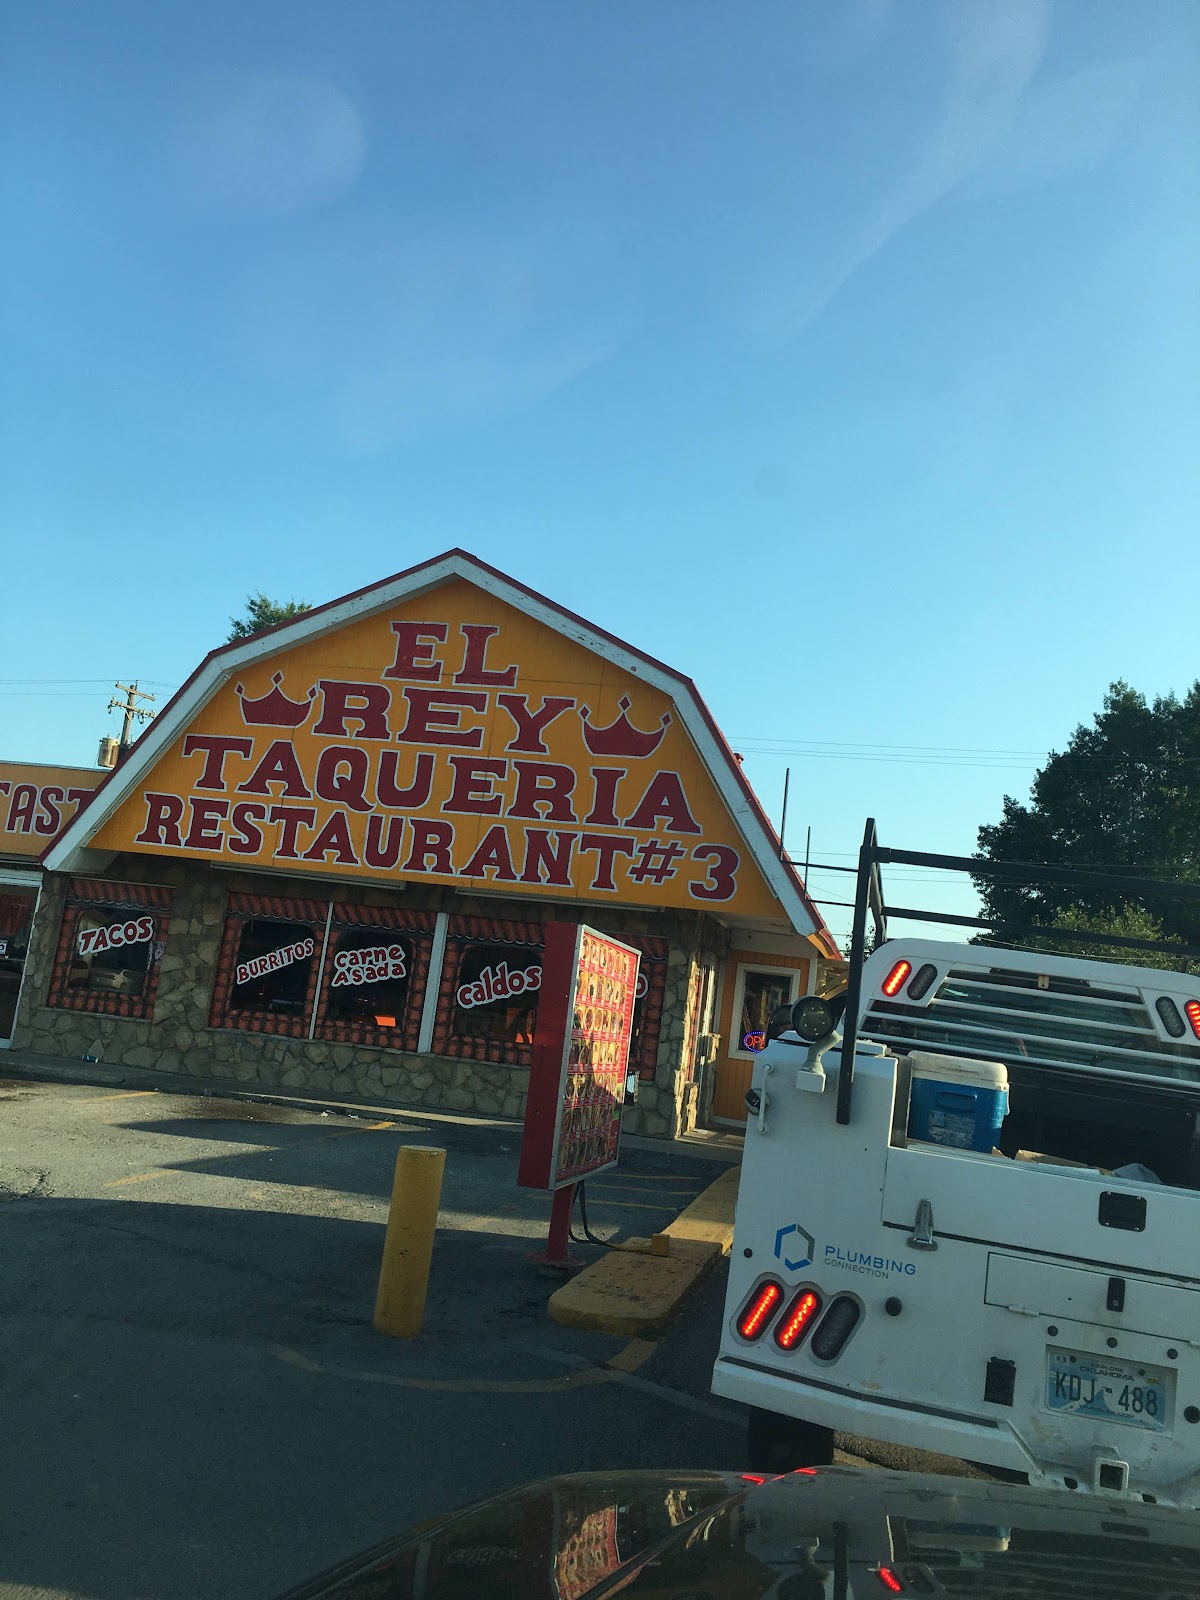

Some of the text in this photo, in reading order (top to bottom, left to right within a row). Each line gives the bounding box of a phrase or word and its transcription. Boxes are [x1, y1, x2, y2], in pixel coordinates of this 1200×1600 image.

[381, 621, 519, 688] EL
[311, 679, 577, 755] REY
[182, 734, 703, 836] TAQUERIA
[133, 791, 636, 892] RESTAURANT
[78, 916, 153, 955] TACOS
[236, 938, 314, 985] BURRITOS
[331, 962, 406, 987] Asada
[457, 961, 542, 1009] caldos
[745, 1035, 765, 1049] OPE
[824, 1258, 889, 1279] CONNECTION
[825, 1245, 916, 1275] PLUMBING
[1080, 1366, 1134, 1382] OKLAHOMA
[1091, 1363, 1125, 1374] EXPLORE
[1055, 1371, 1158, 1416] KDJ 488
